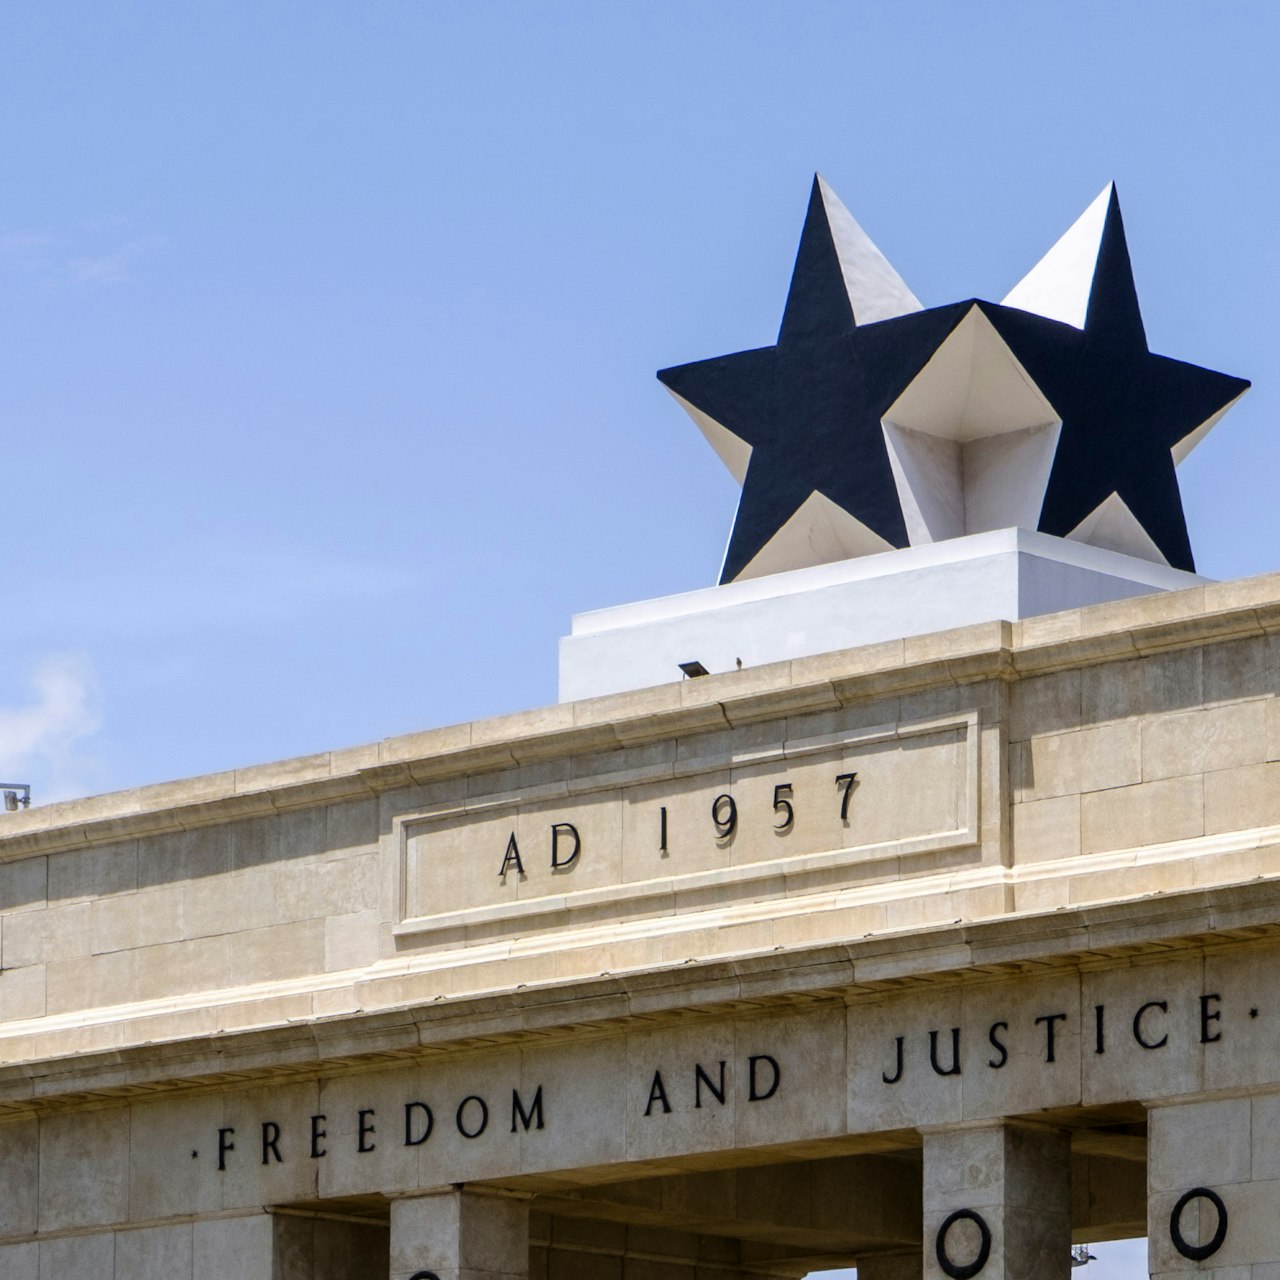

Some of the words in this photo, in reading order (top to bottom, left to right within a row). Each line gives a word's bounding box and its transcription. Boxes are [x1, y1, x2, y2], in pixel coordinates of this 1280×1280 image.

[498, 822, 582, 886] AD
[659, 772, 861, 859] 1957
[217, 1084, 546, 1172] FREEDOM
[643, 1054, 781, 1117] AND
[882, 993, 1222, 1085] JUSTICE
